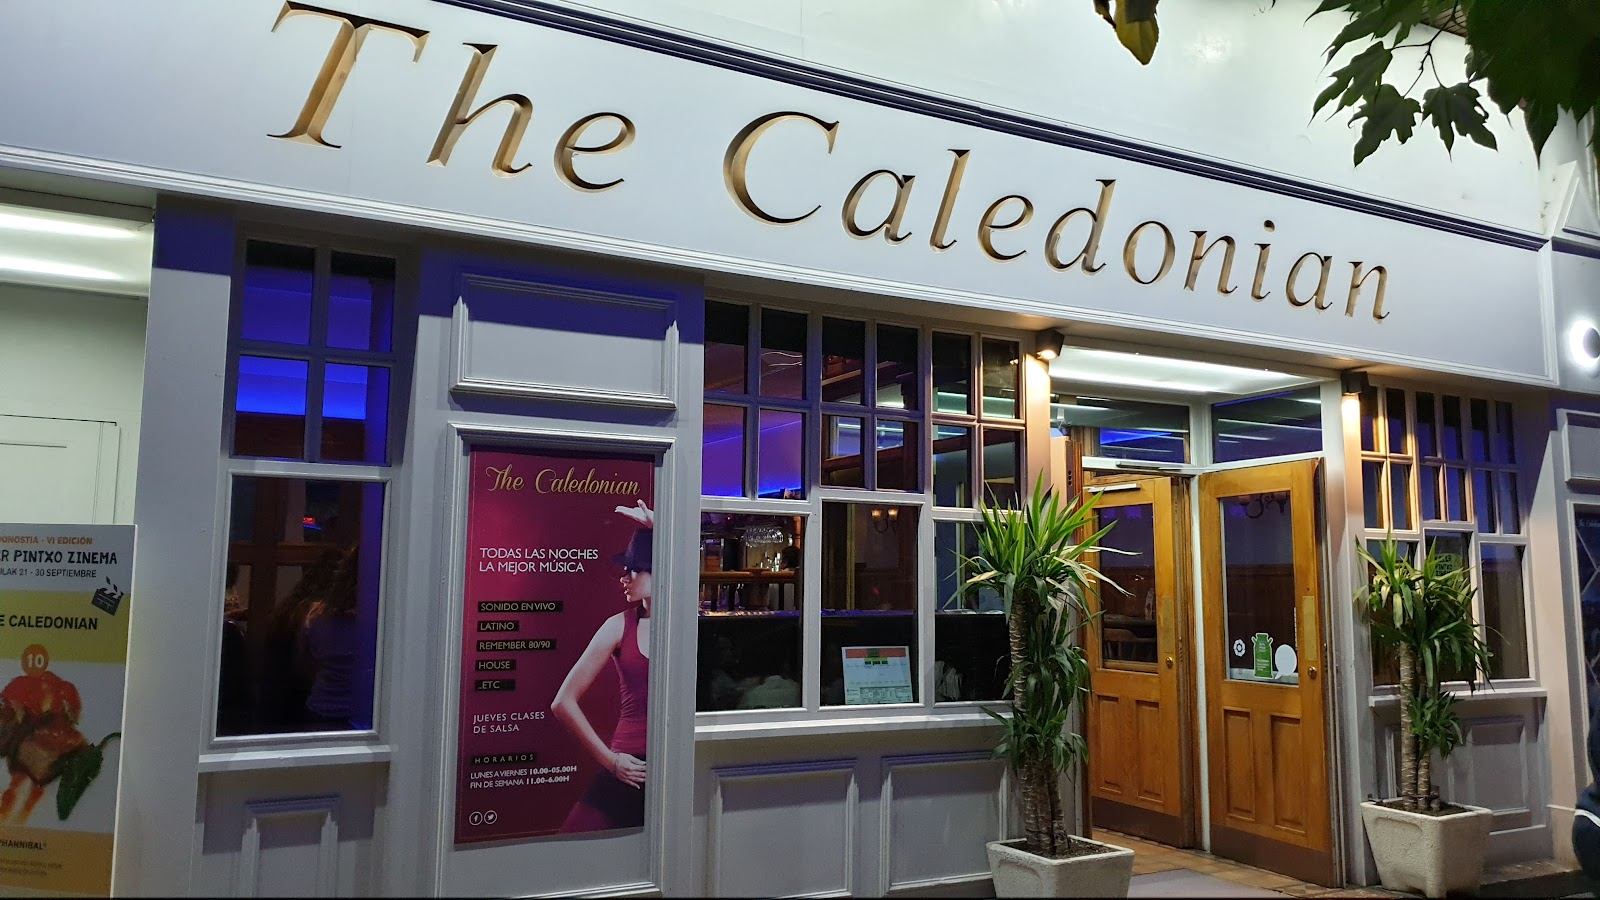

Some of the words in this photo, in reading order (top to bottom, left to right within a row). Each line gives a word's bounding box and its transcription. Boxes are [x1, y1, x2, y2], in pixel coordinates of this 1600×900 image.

[267, 0, 636, 193] The
[722, 110, 1391, 324] Caledonian
[485, 464, 524, 492] The
[535, 466, 641, 495] Caledonian
[13, 549, 63, 563] PINTXO
[67, 551, 118, 565] ZINEMA
[480, 547, 521, 559] TODAS
[525, 548, 546, 559] LAS
[549, 549, 599, 560] NOCHES
[46, 569, 97, 578] SEPTIEMBRE
[479, 561, 495, 572] LA
[498, 561, 536, 575] MEJOR
[540, 560, 585, 573] MÚSICA
[480, 603, 519, 611] SONIDO
[521, 603, 534, 611] EN
[535, 602, 556, 611] VIVO
[8, 614, 99, 630] CALEDONIAN
[480, 622, 515, 631] LATINO
[479, 641, 526, 650] REMEMBER
[528, 641, 551, 649] 80/90
[26, 653, 45, 668] 10
[478, 661, 511, 670] HOUSE
[473, 713, 507, 724] JUEVES
[510, 711, 545, 721] CLASES
[473, 725, 486, 734] DE
[490, 724, 520, 733] SALSA
[470, 770, 494, 780] LUNES
[499, 768, 528, 778] VIERNES
[470, 781, 483, 789] FIN
[483, 780, 494, 788] DE
[494, 777, 525, 787] SEMANA
